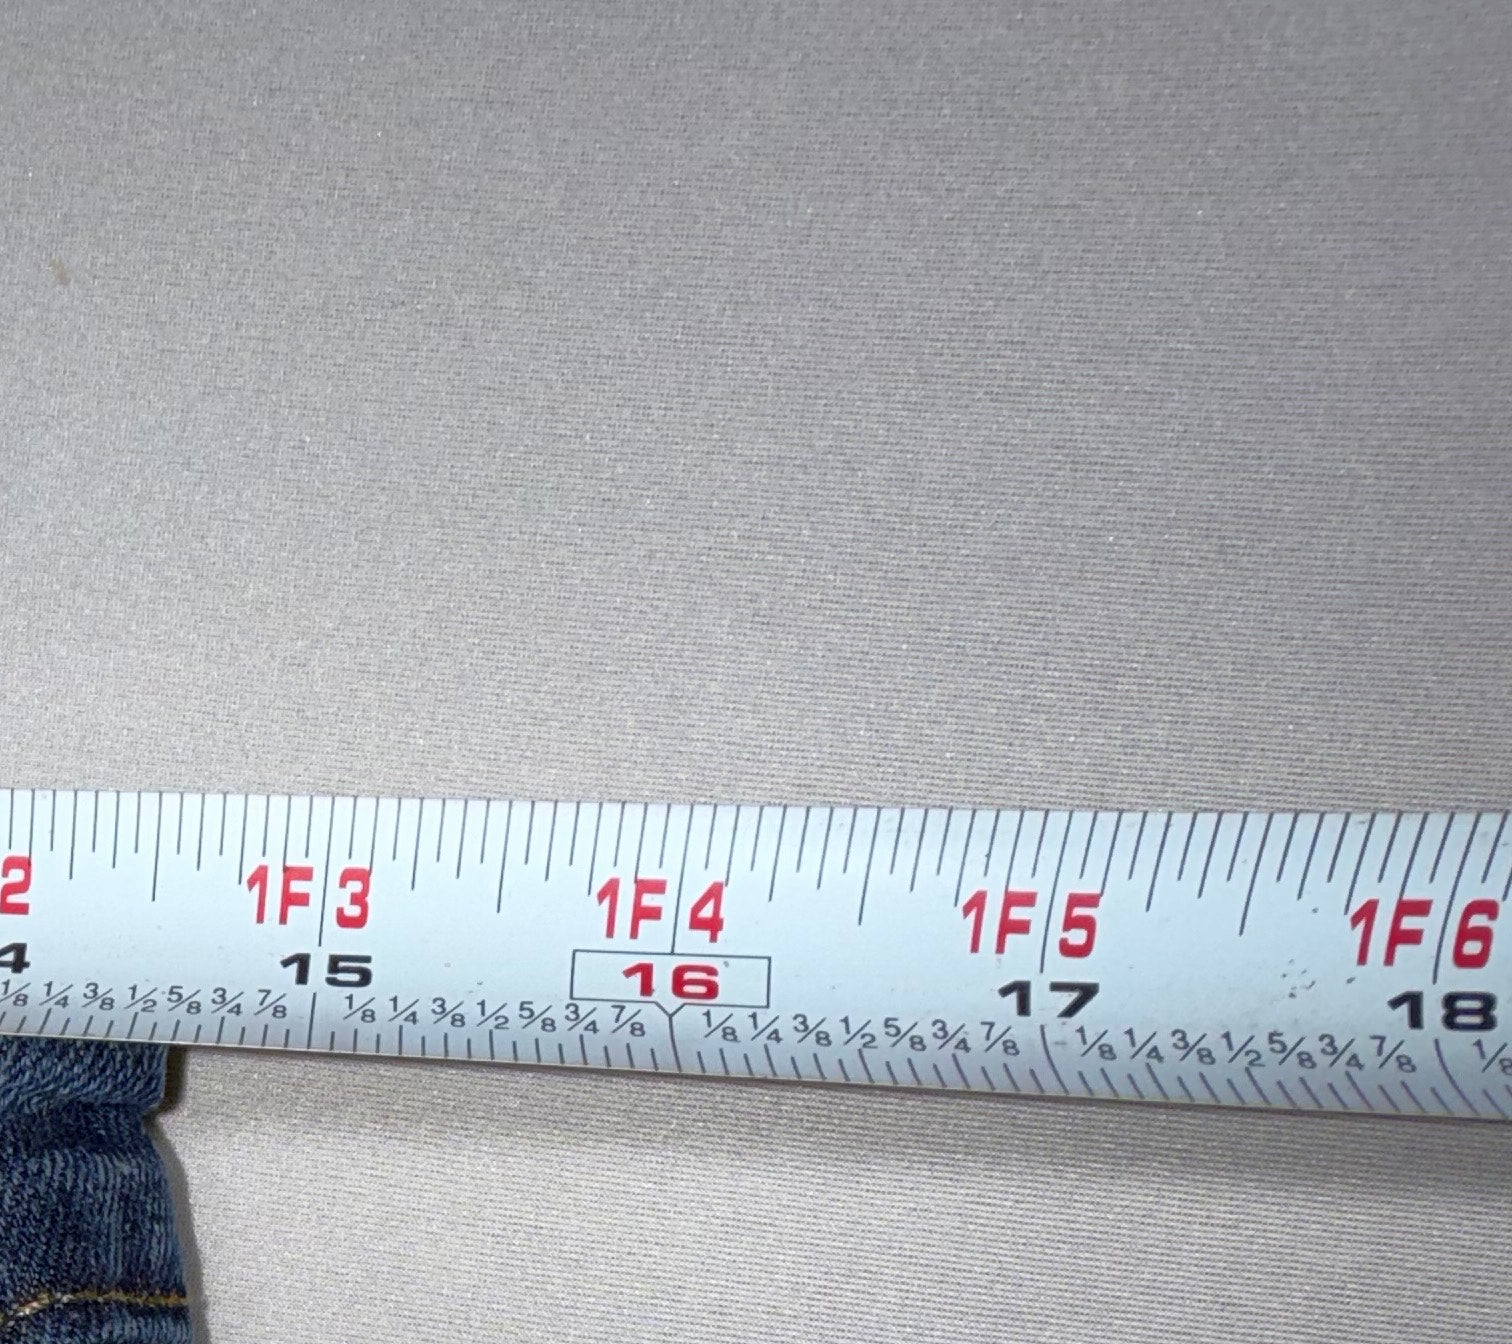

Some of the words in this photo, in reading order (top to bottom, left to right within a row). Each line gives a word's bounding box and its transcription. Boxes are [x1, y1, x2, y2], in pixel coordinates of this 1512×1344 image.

[279, 952, 375, 988] 15
[622, 962, 721, 1000] 16
[998, 979, 1101, 1018] 17
[1387, 990, 1499, 1032] 18
